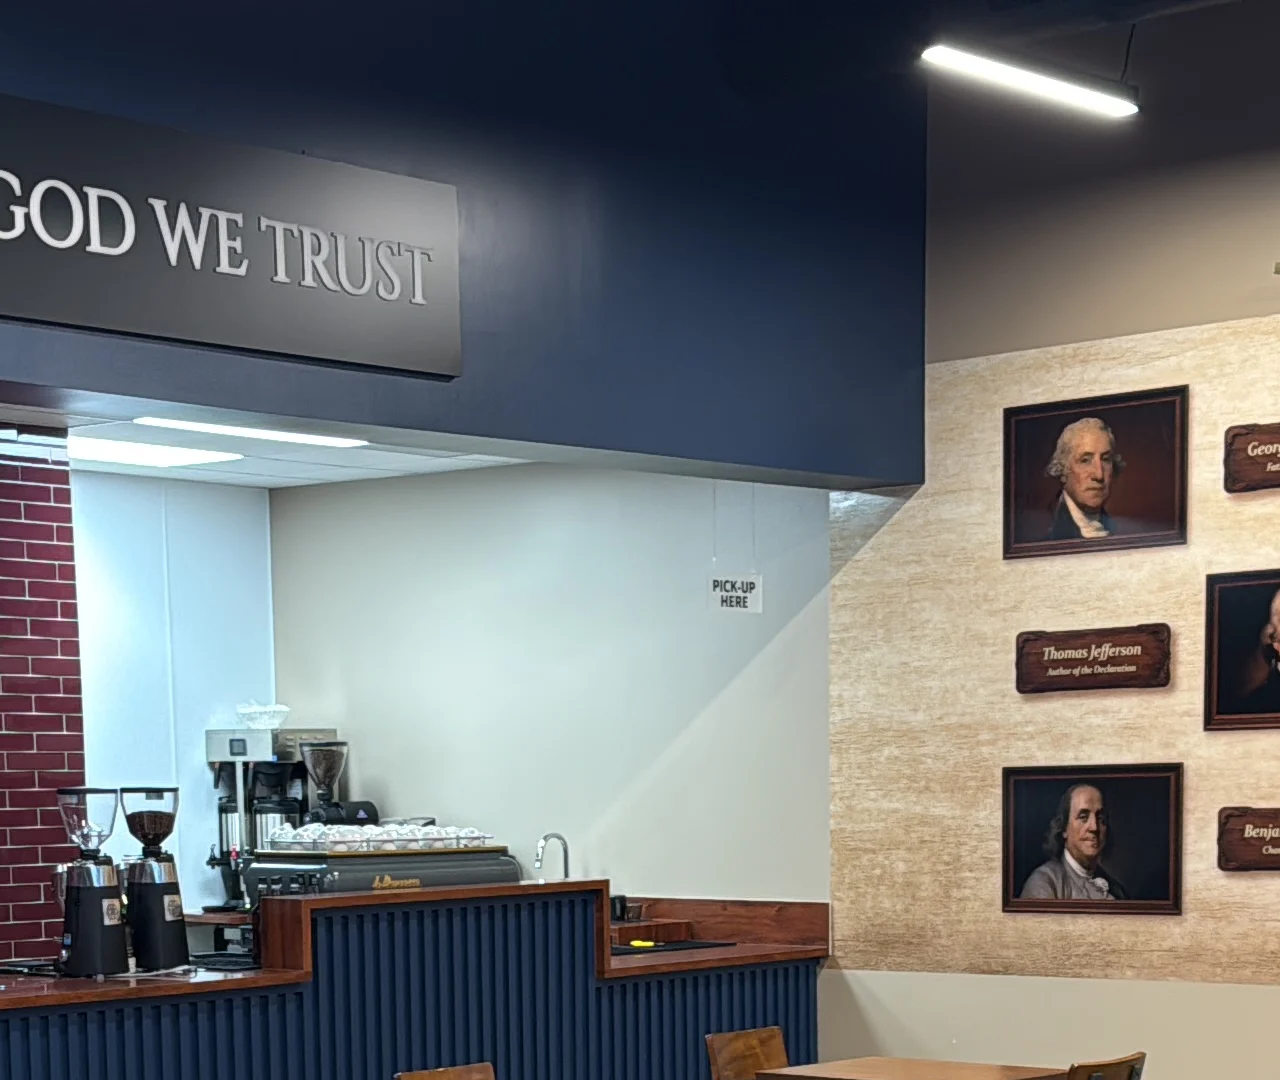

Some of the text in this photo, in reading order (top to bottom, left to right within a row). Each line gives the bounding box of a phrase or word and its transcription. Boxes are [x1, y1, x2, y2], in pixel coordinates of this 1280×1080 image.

[148, 197, 250, 277] WE
[258, 215, 434, 305] TRUST
[712, 579, 756, 593] PICK-UP
[721, 595, 748, 608] HERE
[1043, 642, 1142, 661] Thomas Jefferson
[1047, 664, 1136, 677] Author of the Declaration
